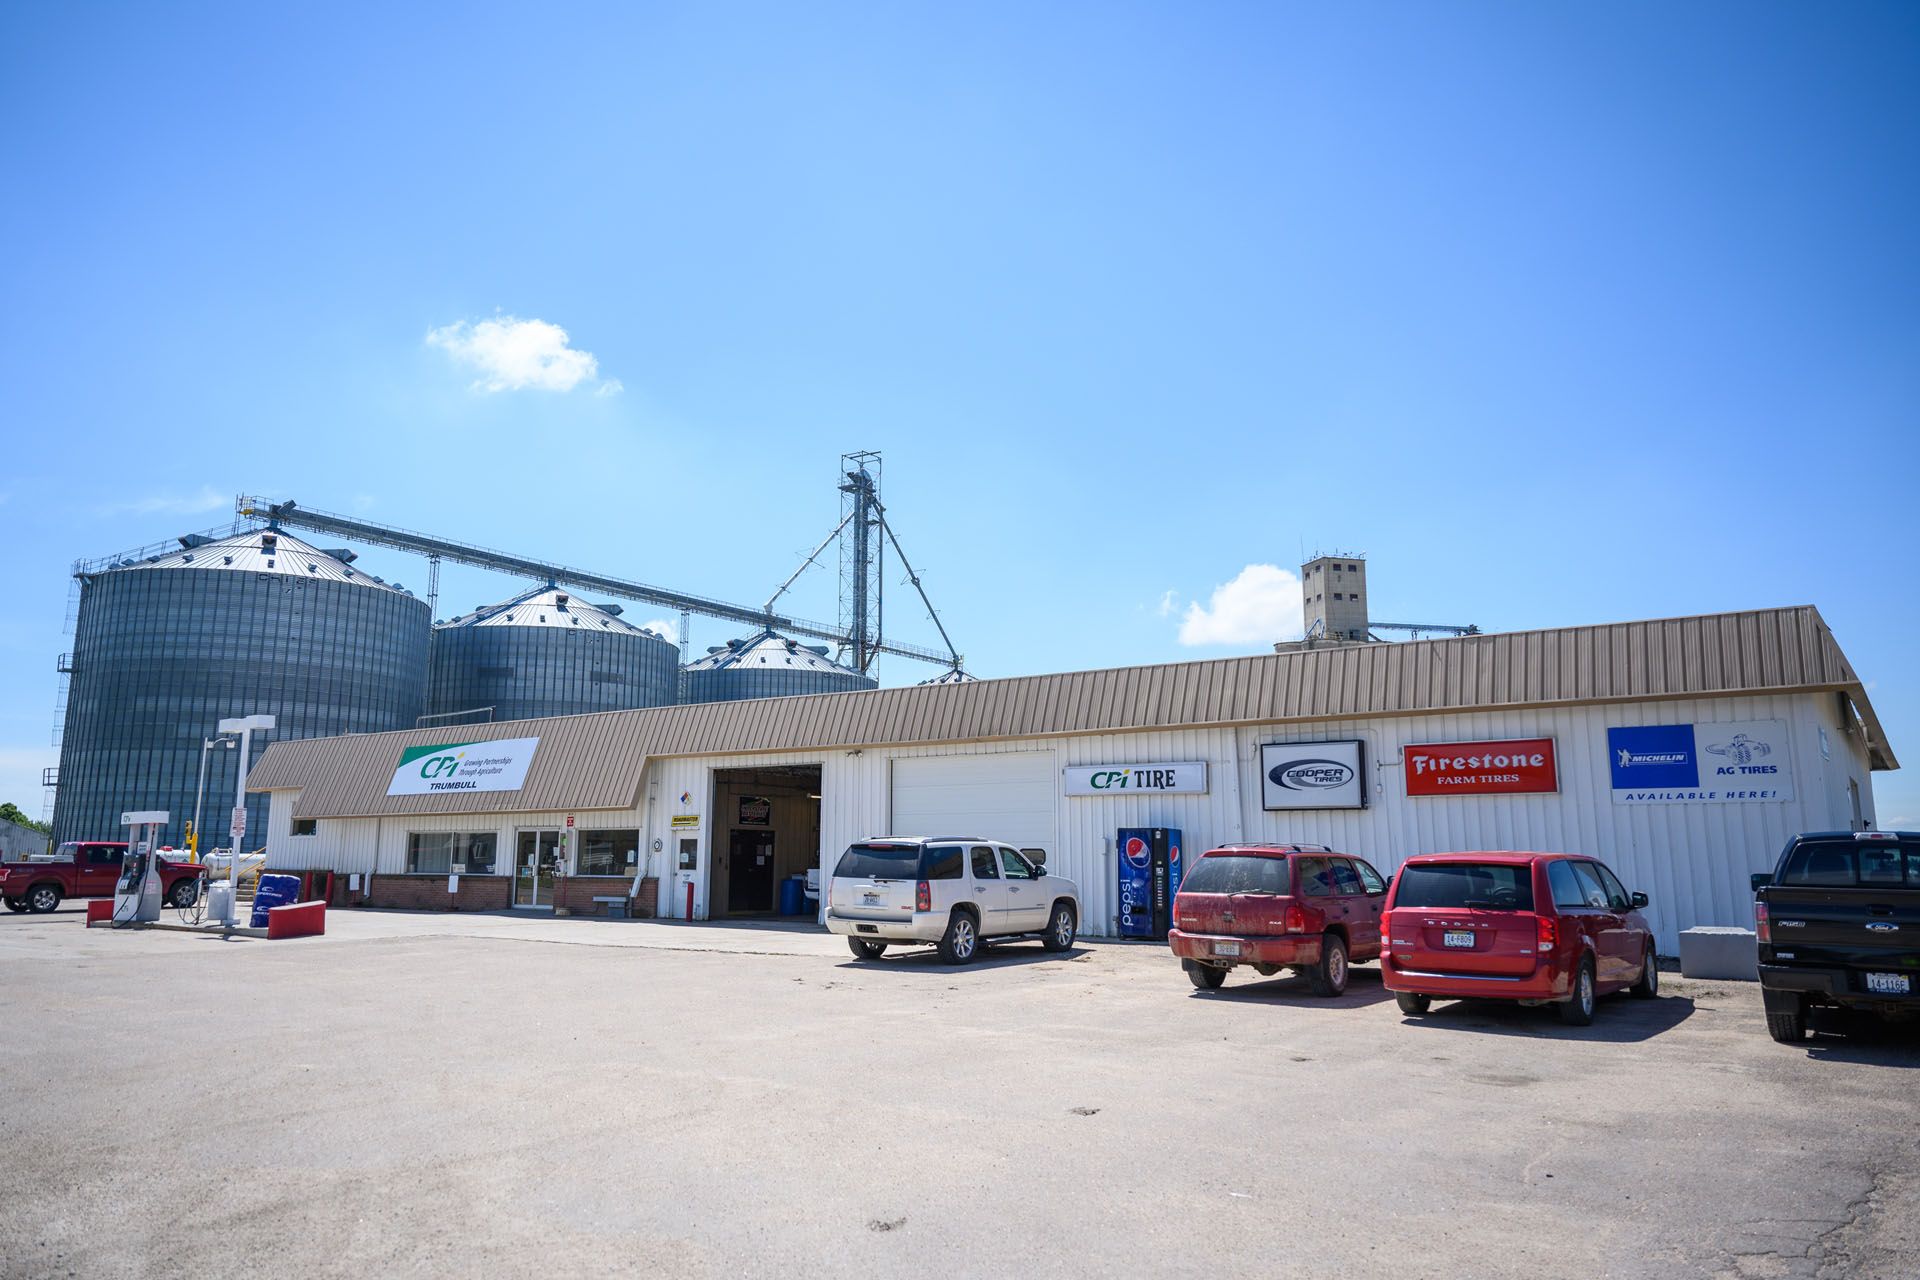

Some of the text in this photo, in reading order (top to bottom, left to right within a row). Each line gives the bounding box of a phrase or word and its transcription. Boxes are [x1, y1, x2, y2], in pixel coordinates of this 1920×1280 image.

[464, 757, 513, 767] Growing Partnerships
[1632, 754, 1684, 763] MICHELIN
[1412, 753, 1544, 775] Firestone
[459, 767, 503, 777] Through Agriculture
[1286, 768, 1344, 778] COOPER
[1717, 765, 1777, 775] AG TIRES
[1134, 769, 1176, 789] TIRE
[1437, 774, 1520, 785] FARM TIRES
[430, 781, 477, 790] TRUMBULL
[1626, 790, 1777, 800] AVAILABLE HERE!
[1120, 879, 1134, 926] pepsi
